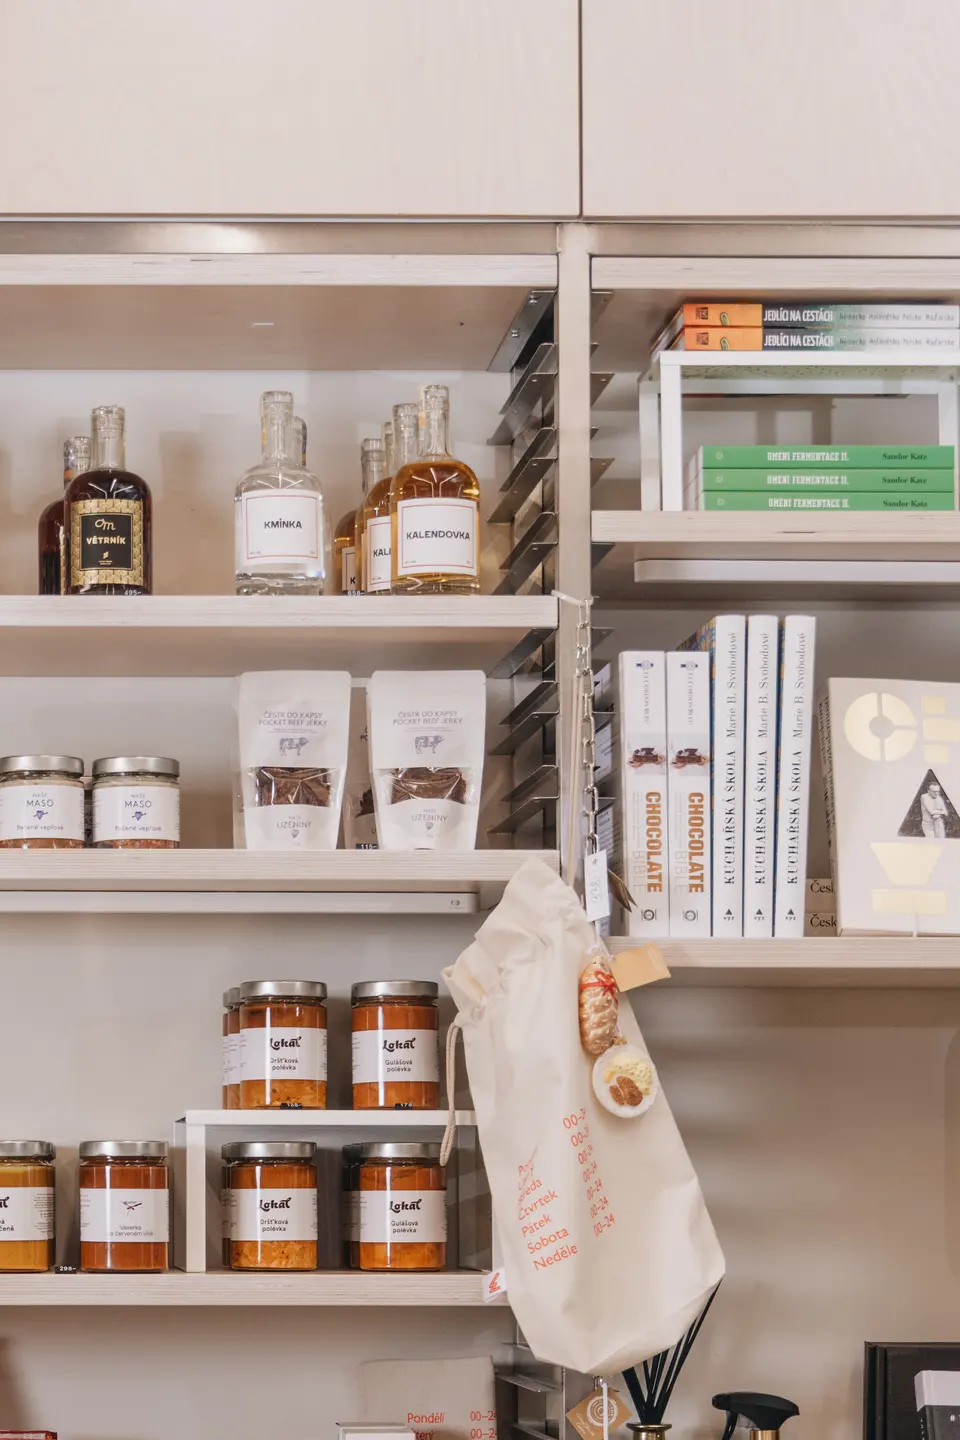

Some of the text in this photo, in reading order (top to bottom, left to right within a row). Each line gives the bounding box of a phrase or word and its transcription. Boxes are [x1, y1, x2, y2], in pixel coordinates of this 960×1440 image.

[790, 309, 801, 322] NA
[802, 307, 833, 322] CESTÁCH
[790, 334, 801, 347] NA
[802, 332, 833, 347] CESTÁCH
[882, 452, 927, 460] Sandor Katz
[882, 476, 927, 484] Sandor Katz
[882, 499, 927, 508] Sandor Katz
[264, 518, 302, 529] KMÍNKA
[86, 535, 126, 545] VĚTRNÍK
[406, 530, 470, 540] KALENDOVKA
[726, 708, 737, 738] Marie
[758, 708, 768, 738] Marie
[792, 708, 803, 738] Marie
[724, 750, 736, 792] ŠKOLA
[755, 750, 768, 792] ŠKOLA
[790, 750, 802, 792] ŠKOLA
[26, 799, 54, 808] MASO
[124, 800, 152, 808] MASO
[277, 821, 312, 829] UZENINY
[411, 814, 448, 822] UZENINY
[645, 792, 663, 893] CHOCOLATE
[688, 792, 704, 893] CHOCOLATE
[722, 797, 736, 884] KUCHAŘSKÁ
[753, 797, 767, 884] KUCHAŘSKÁ
[786, 797, 801, 884] KUCHAŘSKÁ
[272, 1064, 296, 1072] polévka
[262, 1225, 287, 1233] polévka
[522, 1214, 553, 1238] Pátek
[527, 1228, 569, 1254] Sobota
[534, 1243, 578, 1271] Neděle
[407, 1412, 445, 1423] Pondělí
